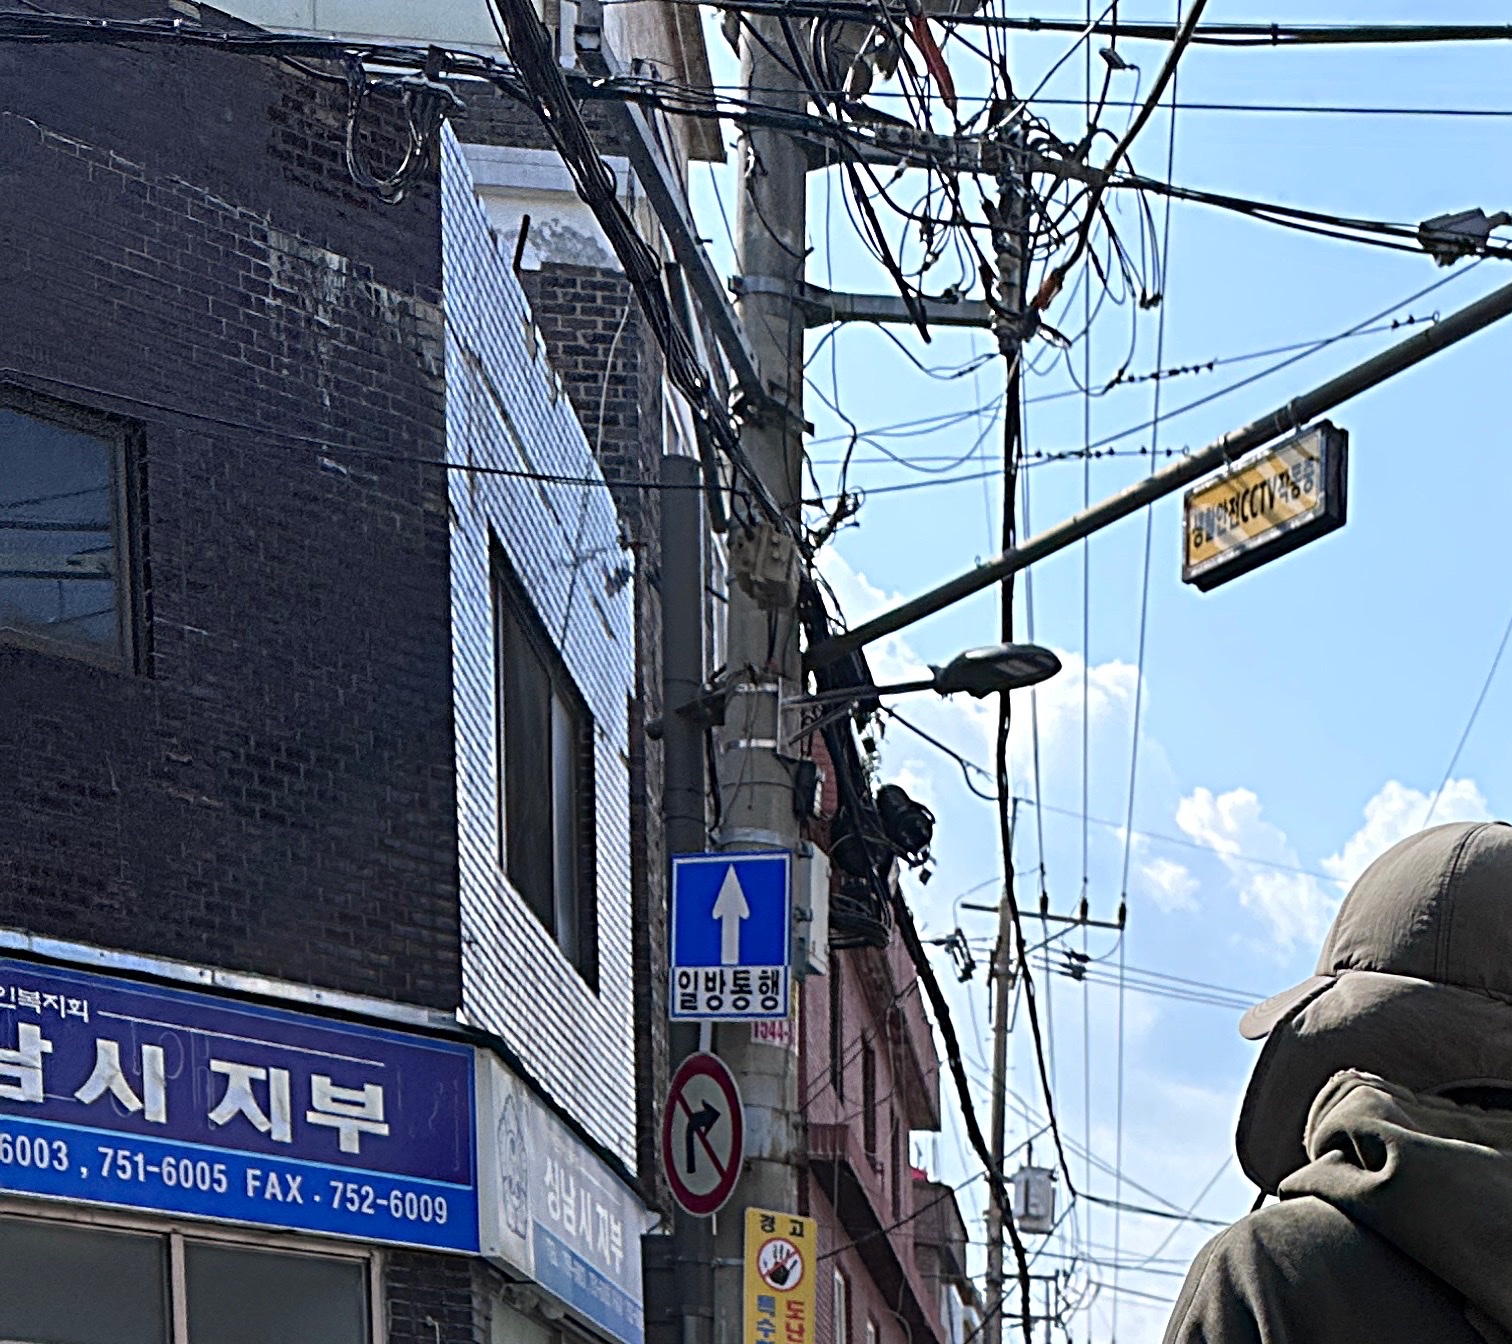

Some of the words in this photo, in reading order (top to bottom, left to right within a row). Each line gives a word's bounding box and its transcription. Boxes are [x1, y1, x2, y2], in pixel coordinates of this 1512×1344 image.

[678, 969, 781, 1011] 일방통행
[98, 1146, 228, 1194] 751-6005
[329, 1181, 448, 1225] 752-6009
